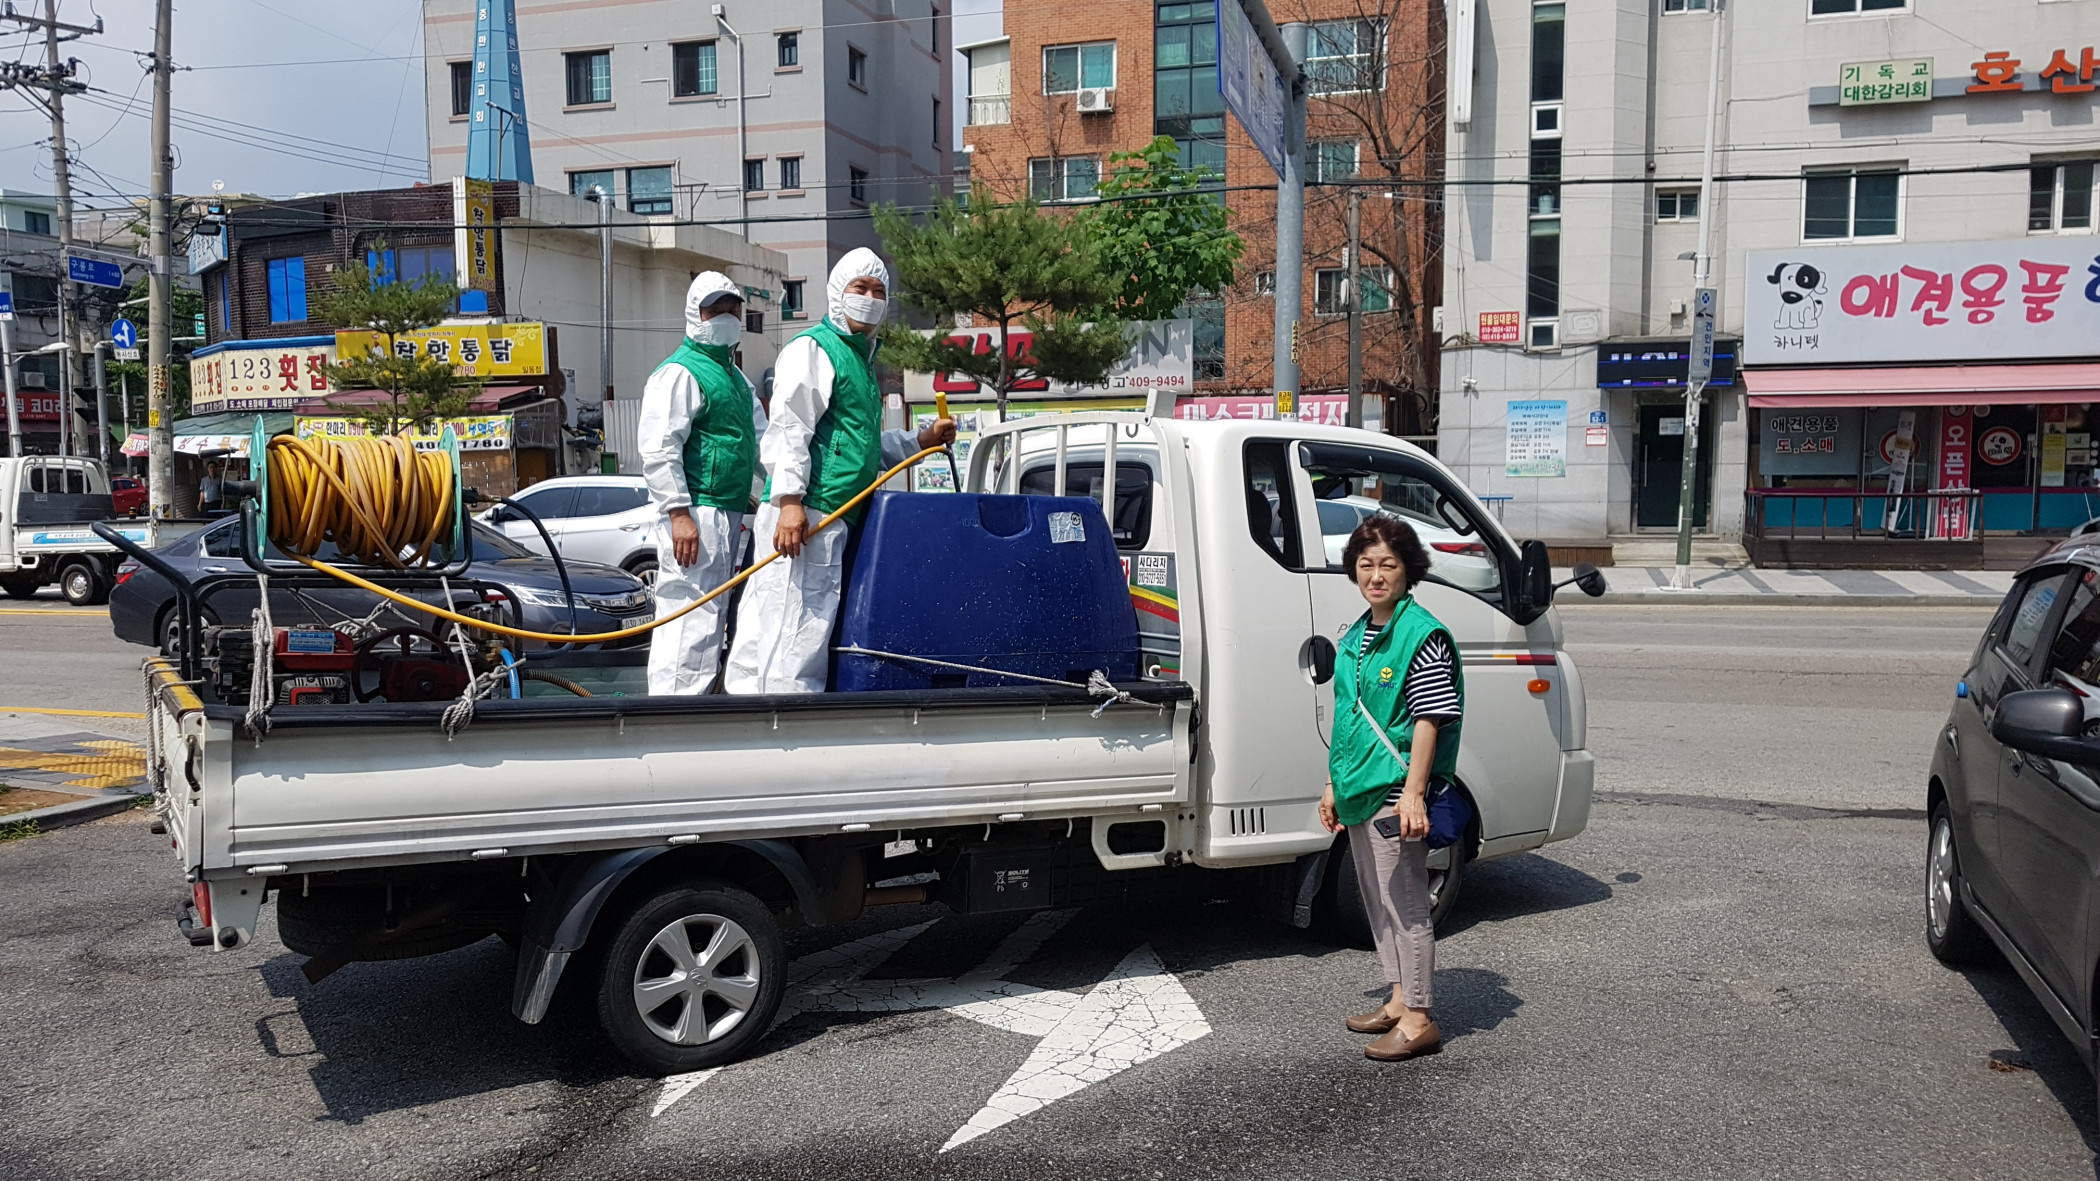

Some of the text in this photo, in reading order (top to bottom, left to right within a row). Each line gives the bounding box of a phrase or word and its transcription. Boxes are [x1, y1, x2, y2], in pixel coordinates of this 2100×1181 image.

[1845, 62, 1929, 82] 기독교
[1843, 81, 1928, 102] 대한감리회
[1840, 259, 2070, 326] 애견용품
[1703, 322, 1713, 368] 견인지역
[1773, 335, 1820, 350] 하니펫
[230, 354, 328, 392] 123 횟집
[1129, 376, 1185, 387] 409-9494
[1771, 416, 1839, 433] 애견용품
[1776, 437, 1834, 453] 도.소매
